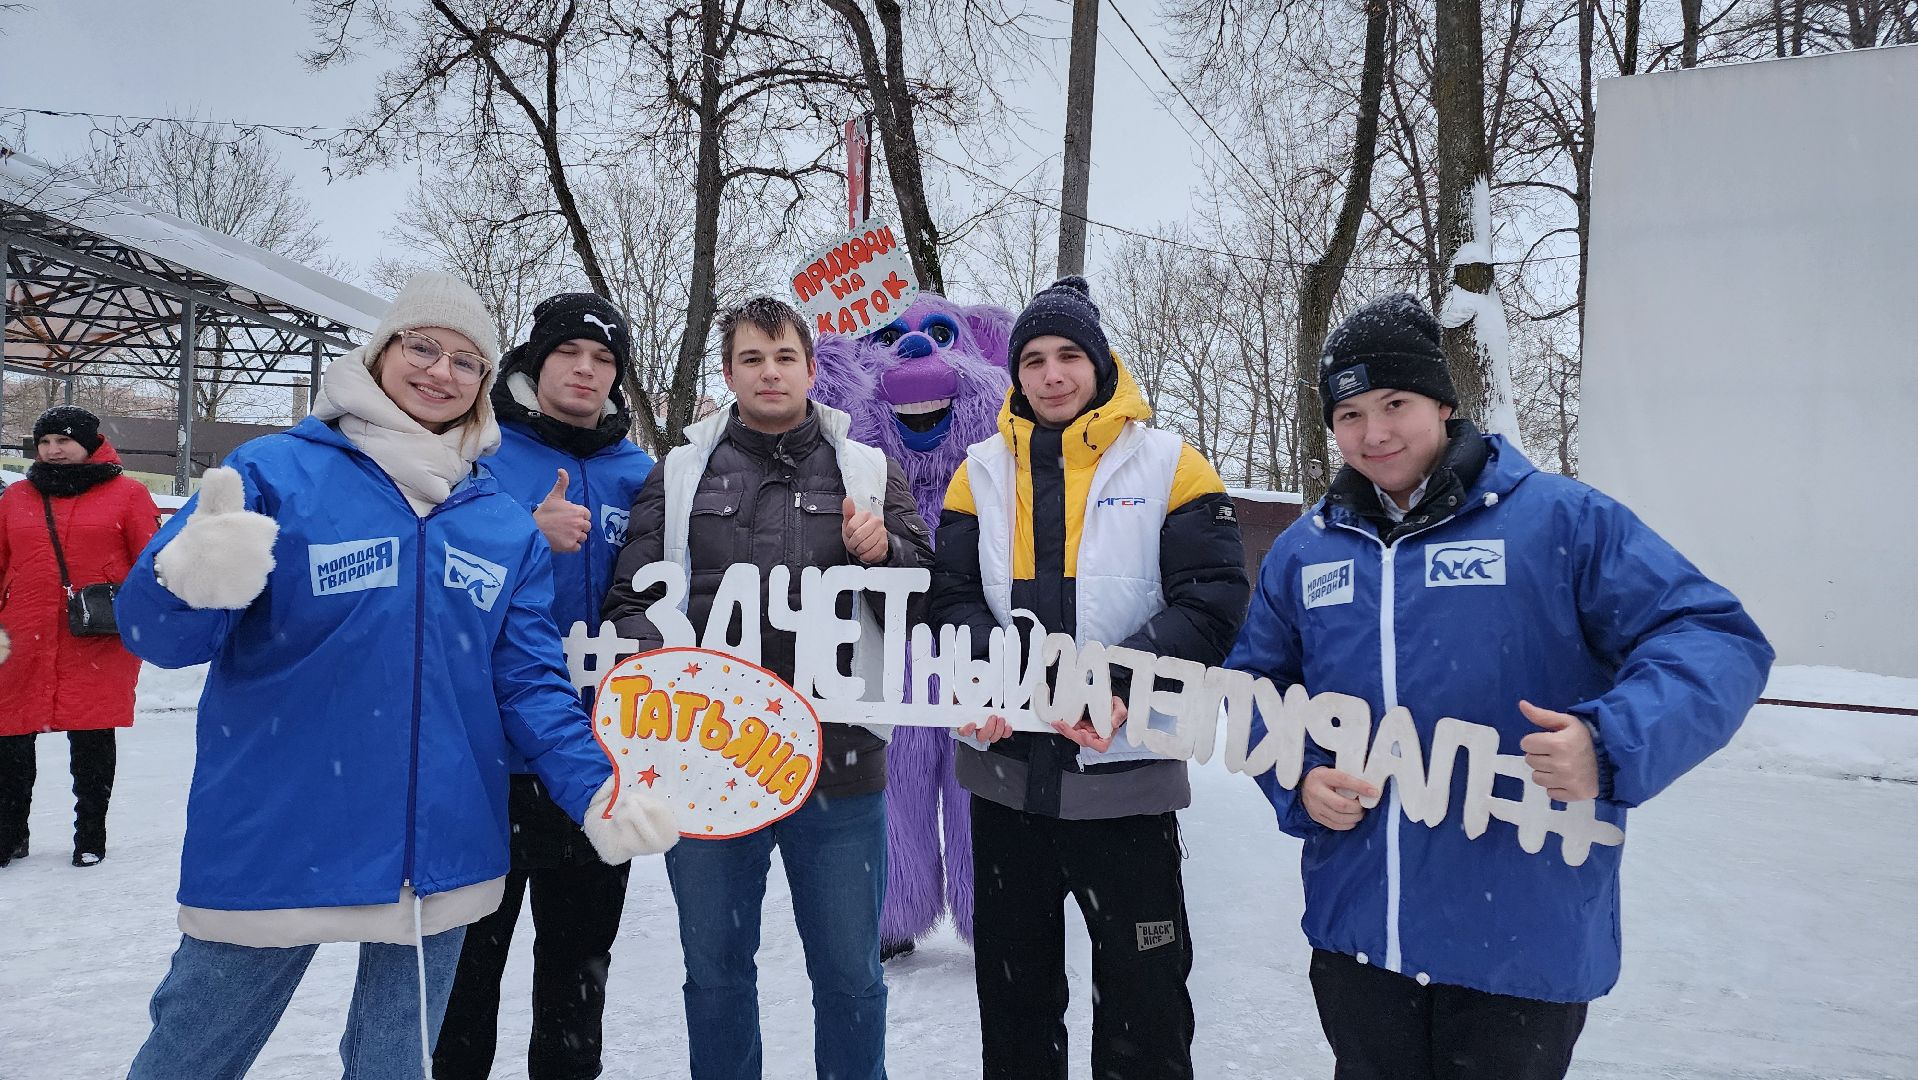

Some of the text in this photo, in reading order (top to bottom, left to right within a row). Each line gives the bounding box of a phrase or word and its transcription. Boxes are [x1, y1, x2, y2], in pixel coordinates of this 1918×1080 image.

[792, 225, 896, 303] ПРИХОДИ
[830, 273, 866, 300] НА
[817, 271, 909, 335] КАТОК
[1097, 497, 1146, 508] МГЕР
[317, 540, 393, 577] МОЛОДАЯ
[610, 675, 812, 805] ТАТЬЯНА
[1142, 924, 1170, 936] BLACK
[1143, 935, 1163, 946] NICE
